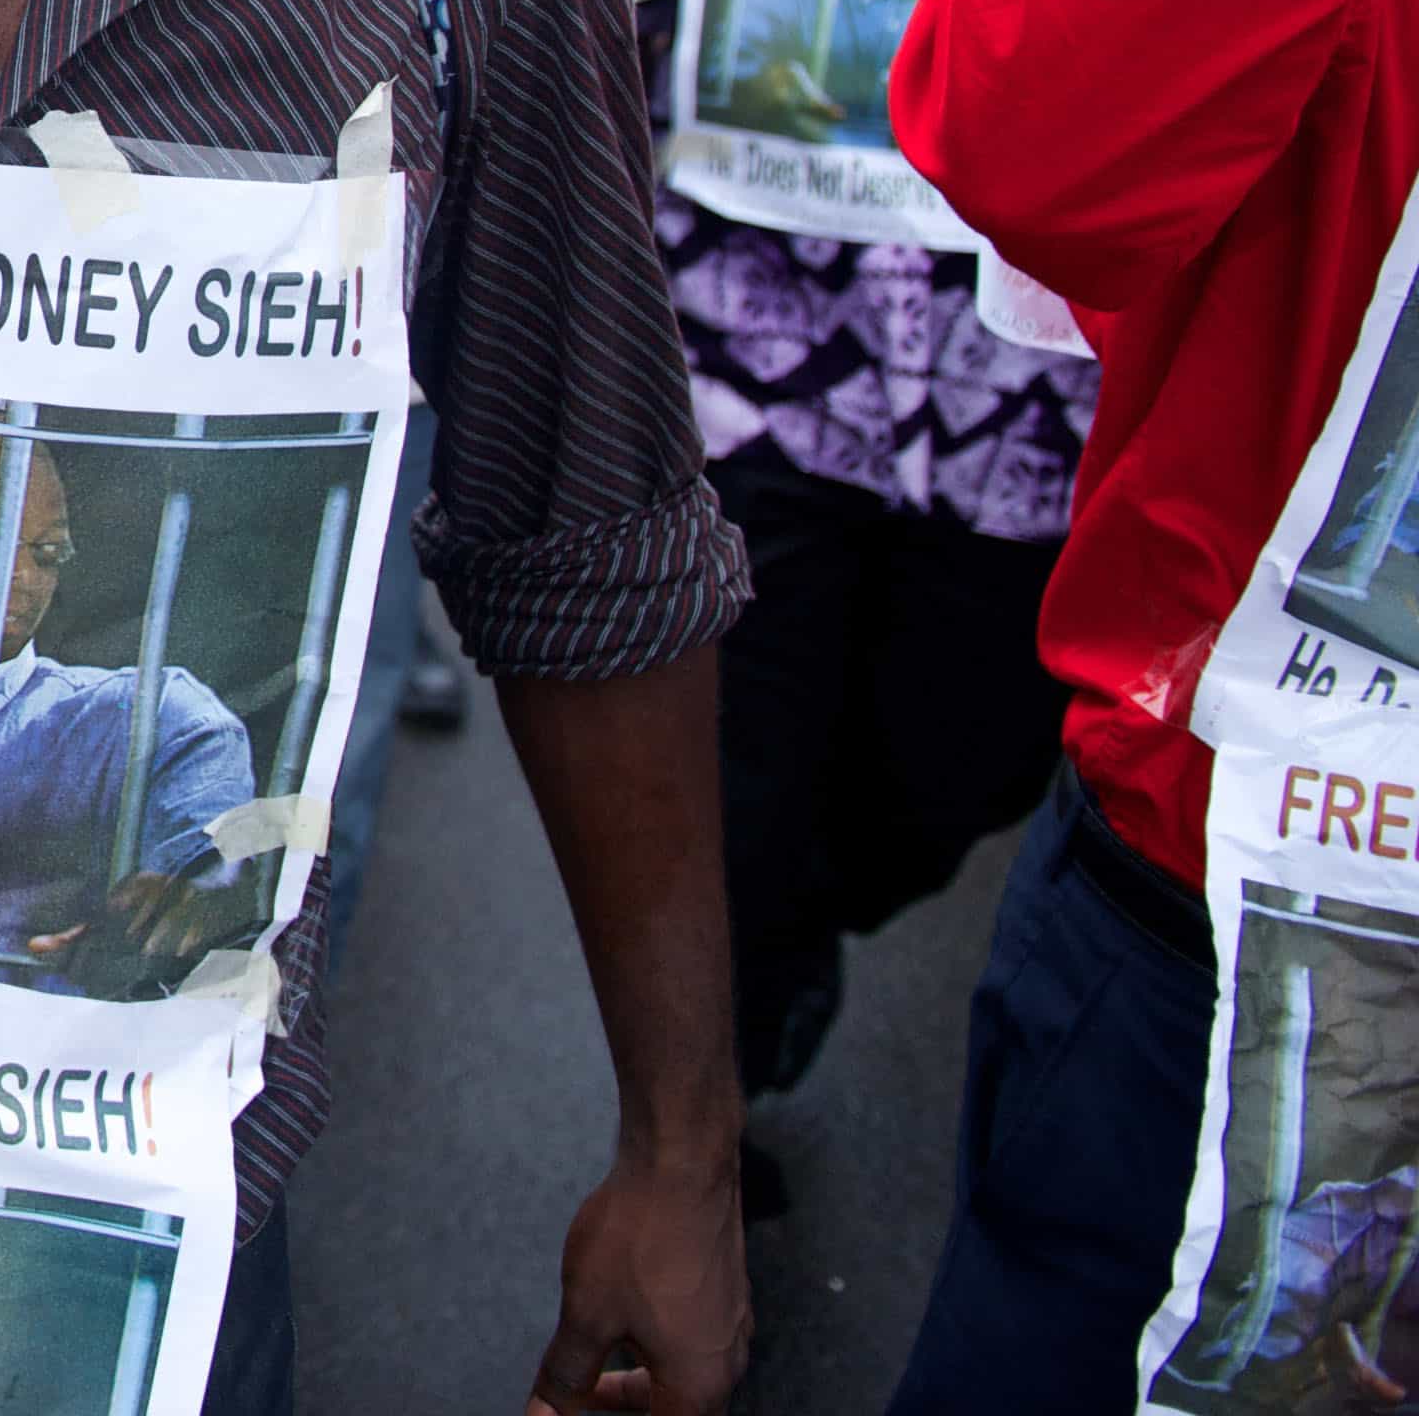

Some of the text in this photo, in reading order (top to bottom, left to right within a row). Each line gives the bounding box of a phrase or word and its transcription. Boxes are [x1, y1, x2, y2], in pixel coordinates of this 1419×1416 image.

[746, 138, 801, 192] Does
[806, 151, 846, 203] Not
[186, 264, 365, 359] SIEH!
[1278, 765, 1419, 863] FRE
